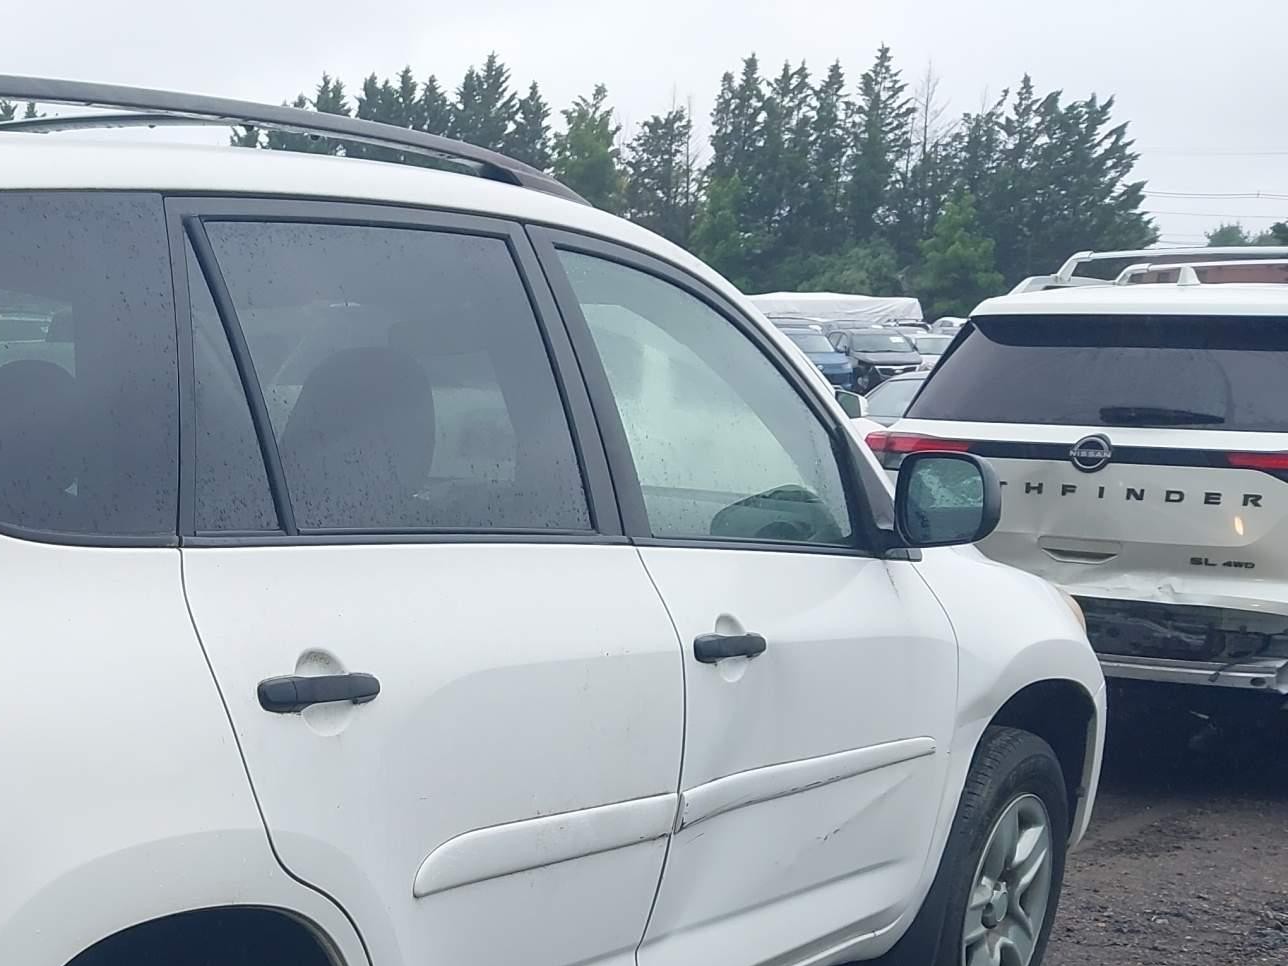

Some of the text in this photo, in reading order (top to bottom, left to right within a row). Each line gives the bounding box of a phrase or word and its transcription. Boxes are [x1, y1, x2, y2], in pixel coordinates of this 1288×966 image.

[1069, 449, 1111, 458] NISSAN
[1190, 557, 1256, 569] SL 4WD
